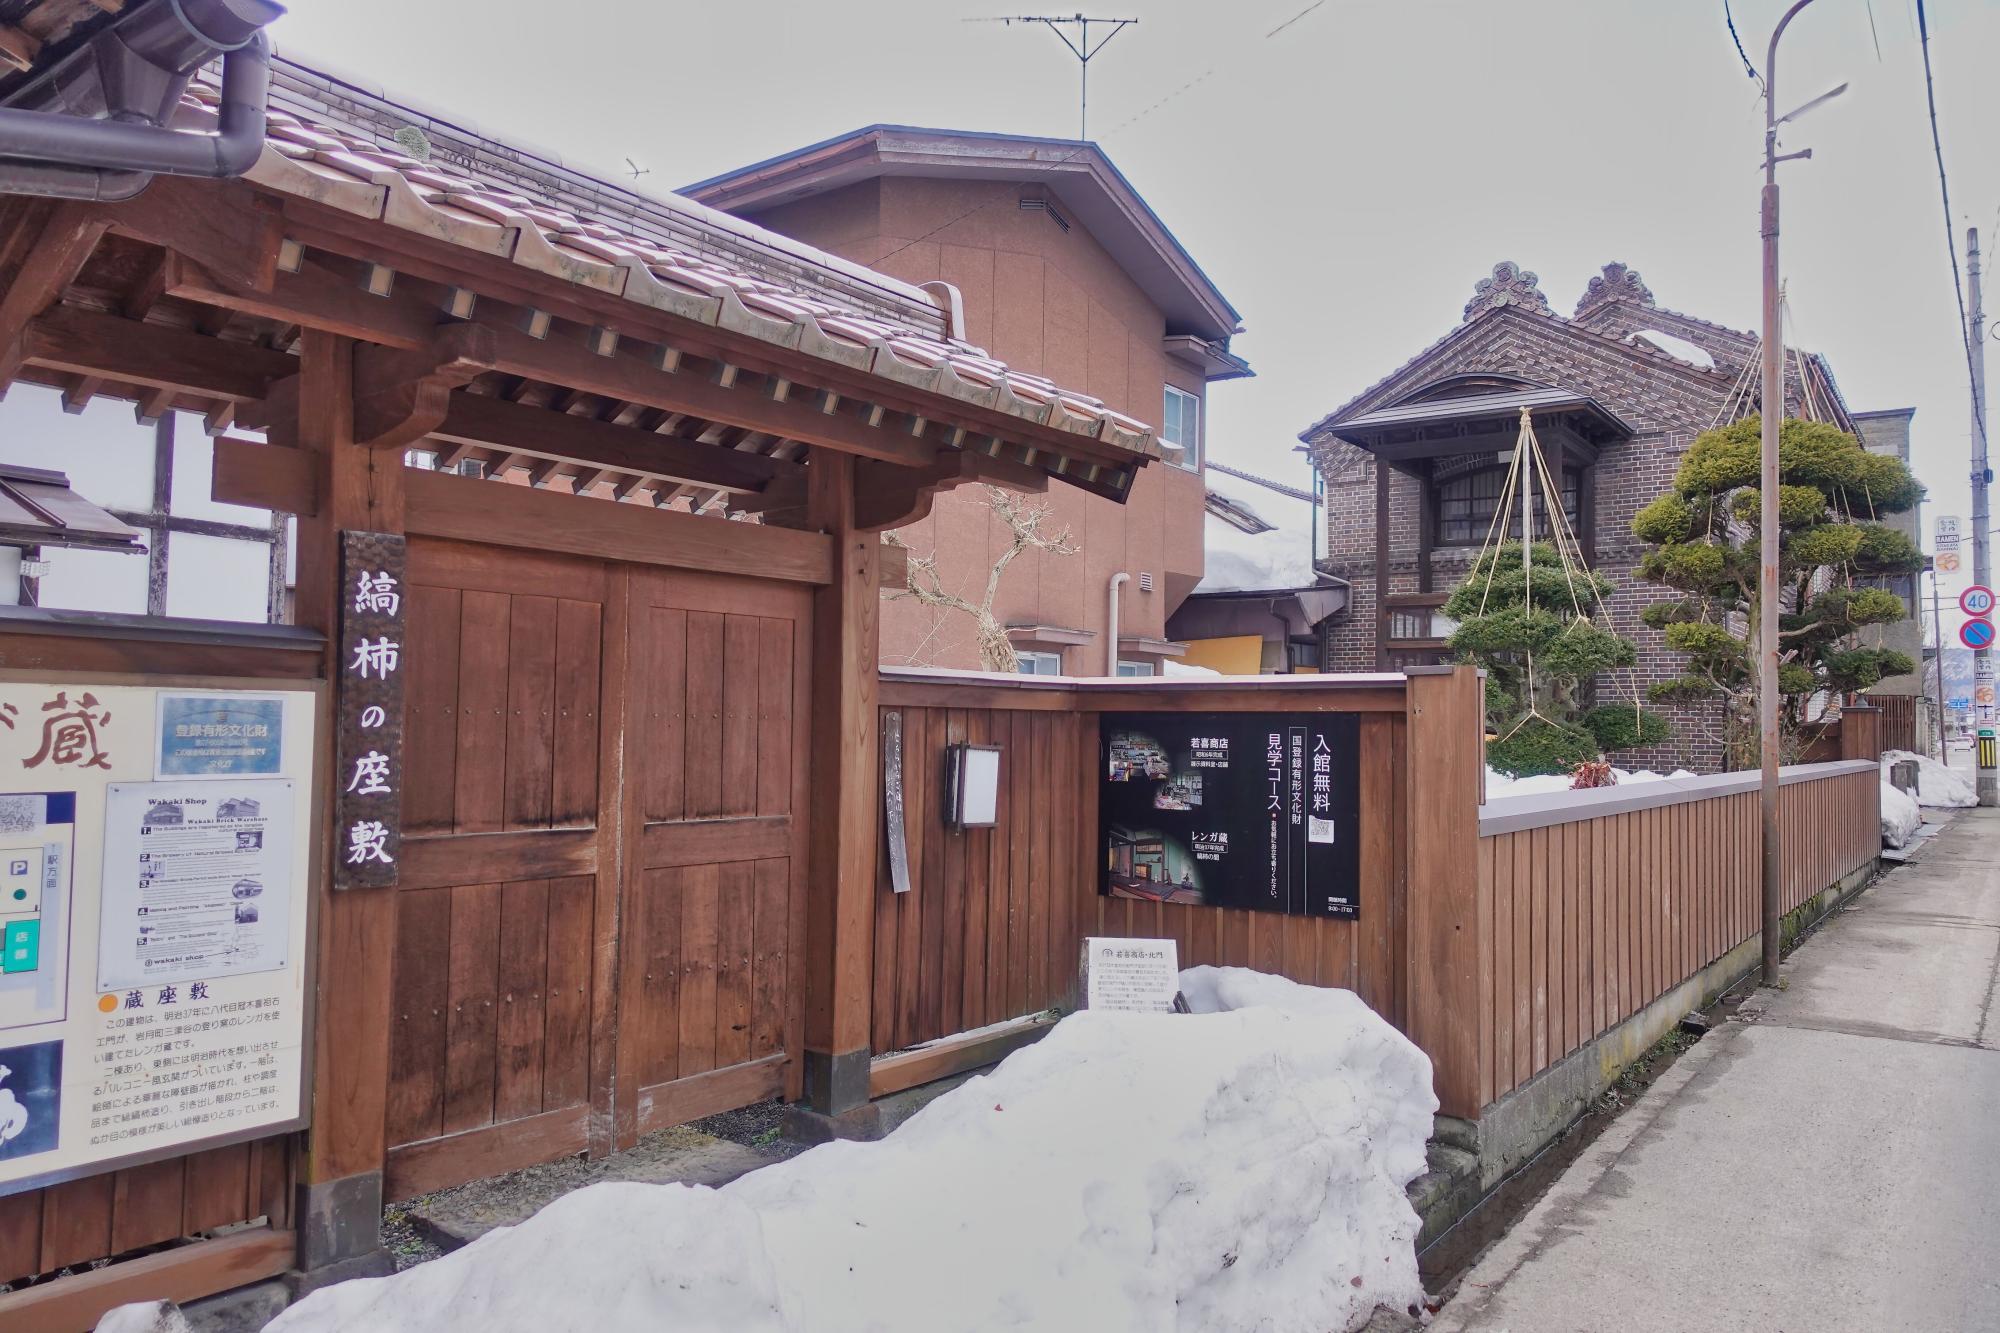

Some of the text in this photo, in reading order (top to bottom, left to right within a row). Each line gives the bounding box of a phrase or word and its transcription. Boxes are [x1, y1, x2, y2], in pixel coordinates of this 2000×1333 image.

[1968, 595, 1988, 608] 40
[176, 724, 268, 737] 登録有形文化財
[348, 571, 400, 864] 縞柿の座敷
[1190, 737, 1228, 749] 若喜商店
[1267, 733, 1283, 811] 見学コース
[1291, 736, 1302, 825] 国登録有形文化財
[1313, 734, 1331, 812] 入館無料
[1191, 831, 1227, 843] レンガ蔵
[124, 982, 210, 1009] 蔵座敷
